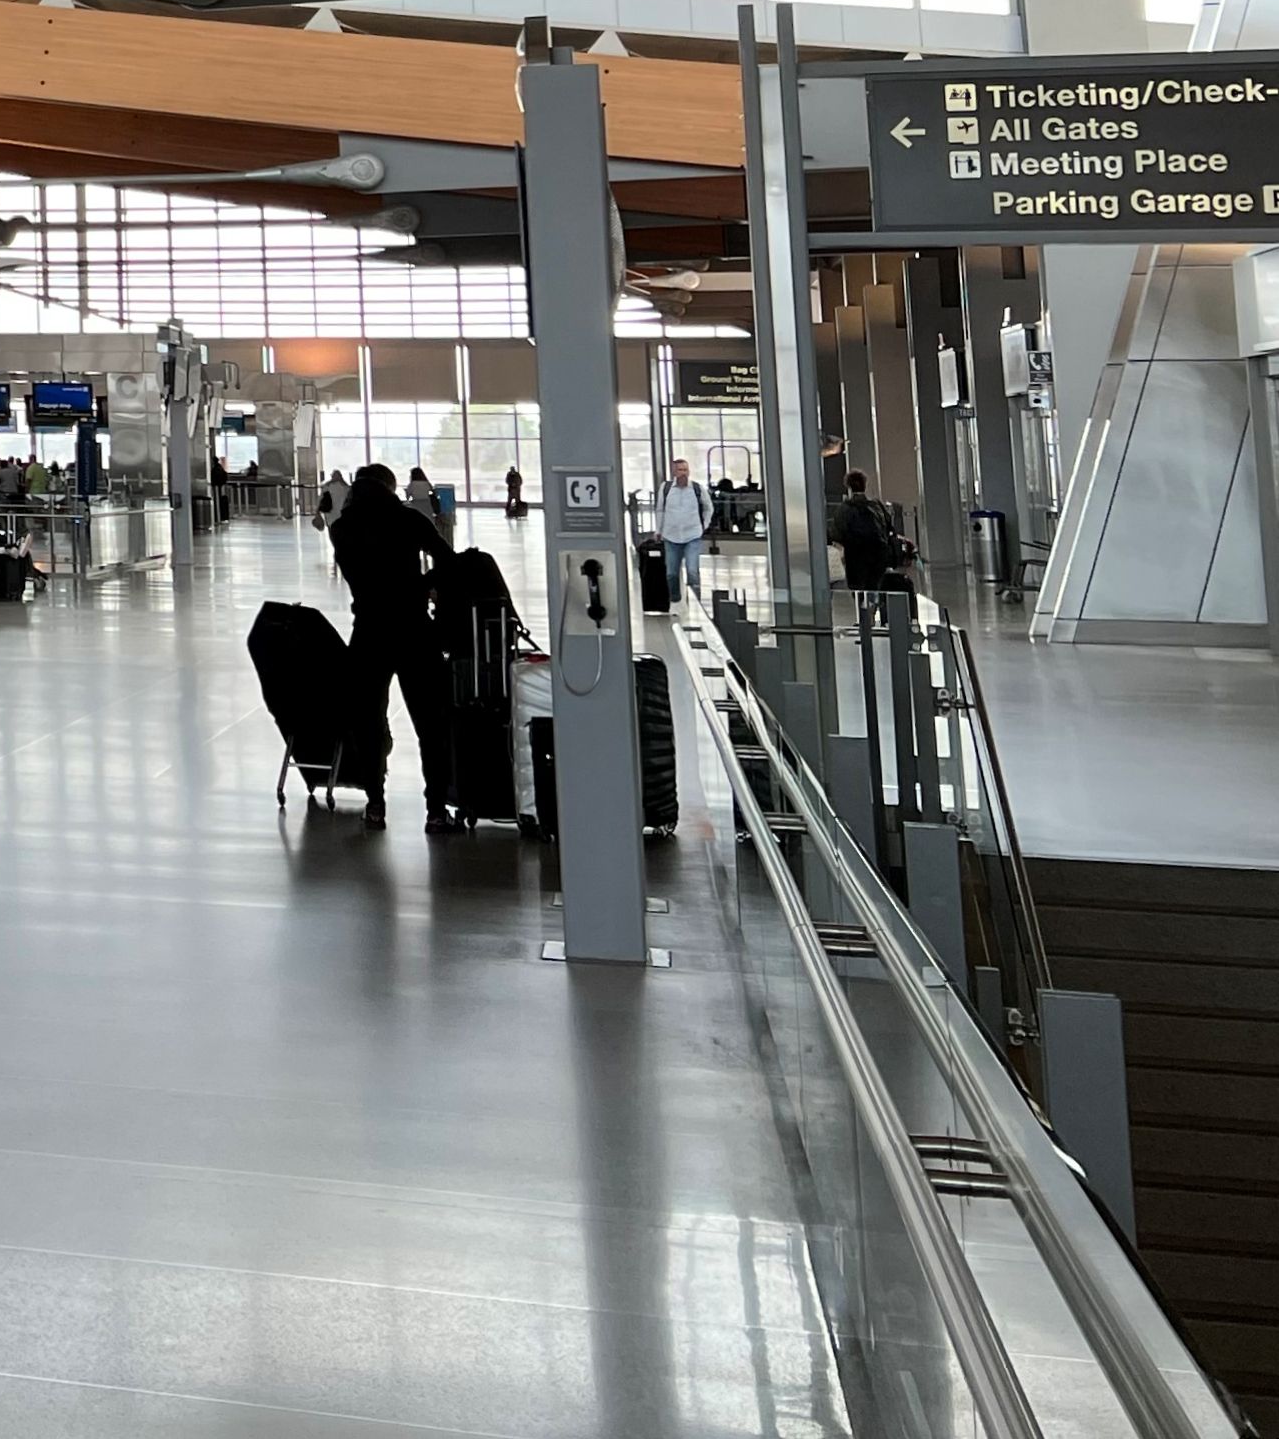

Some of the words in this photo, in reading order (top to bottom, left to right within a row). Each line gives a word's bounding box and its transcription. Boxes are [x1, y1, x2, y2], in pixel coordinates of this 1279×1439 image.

[990, 118, 1031, 142] All
[1041, 117, 1140, 141] Gates
[990, 150, 1124, 180] Meeting
[1134, 149, 1229, 174] Place
[992, 191, 1120, 220] Parking
[1130, 189, 1254, 219] Garage
[700, 375, 732, 384] Ground
[730, 366, 748, 375] Bag
[115, 374, 139, 400] C
[688, 394, 741, 403] International
